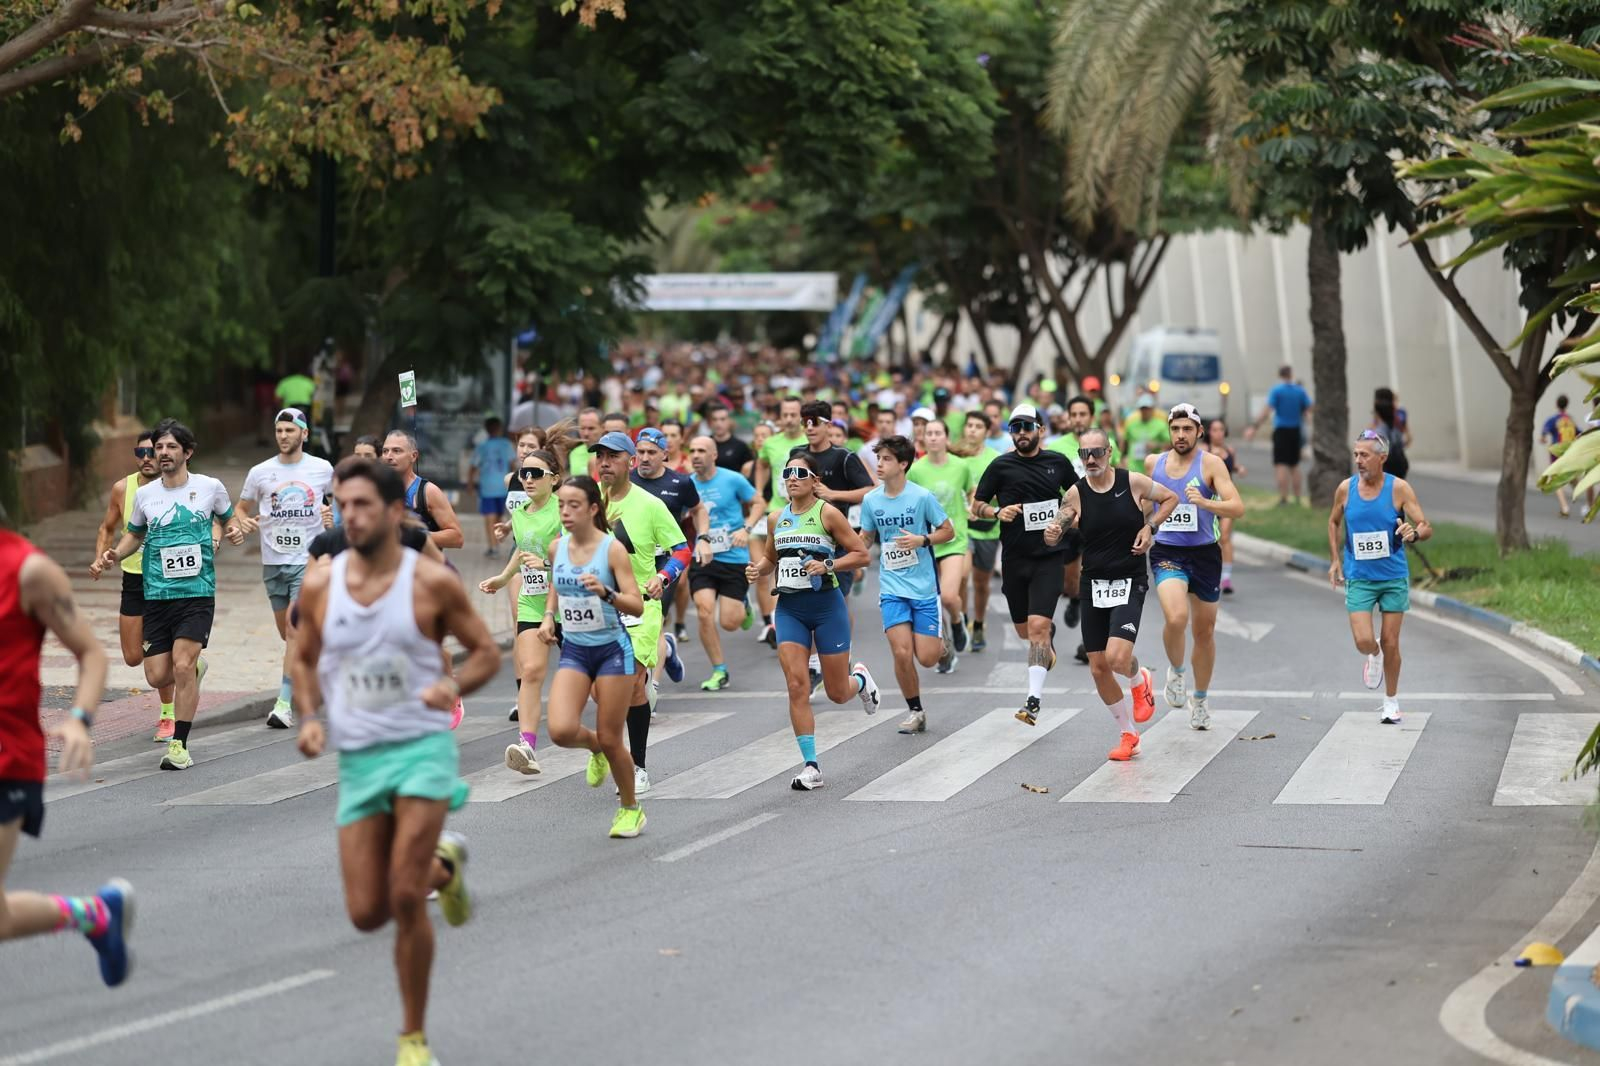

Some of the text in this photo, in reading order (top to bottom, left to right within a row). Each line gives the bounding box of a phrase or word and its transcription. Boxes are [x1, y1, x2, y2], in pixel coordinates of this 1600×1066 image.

[876, 513, 915, 528] nerja
[1029, 509, 1055, 522] 604
[276, 535, 301, 546] 699
[1358, 541, 1383, 551] 583
[166, 555, 196, 569] 218
[780, 568, 808, 578] 1126
[523, 574, 544, 584] 1023
[564, 609, 595, 621] 834
